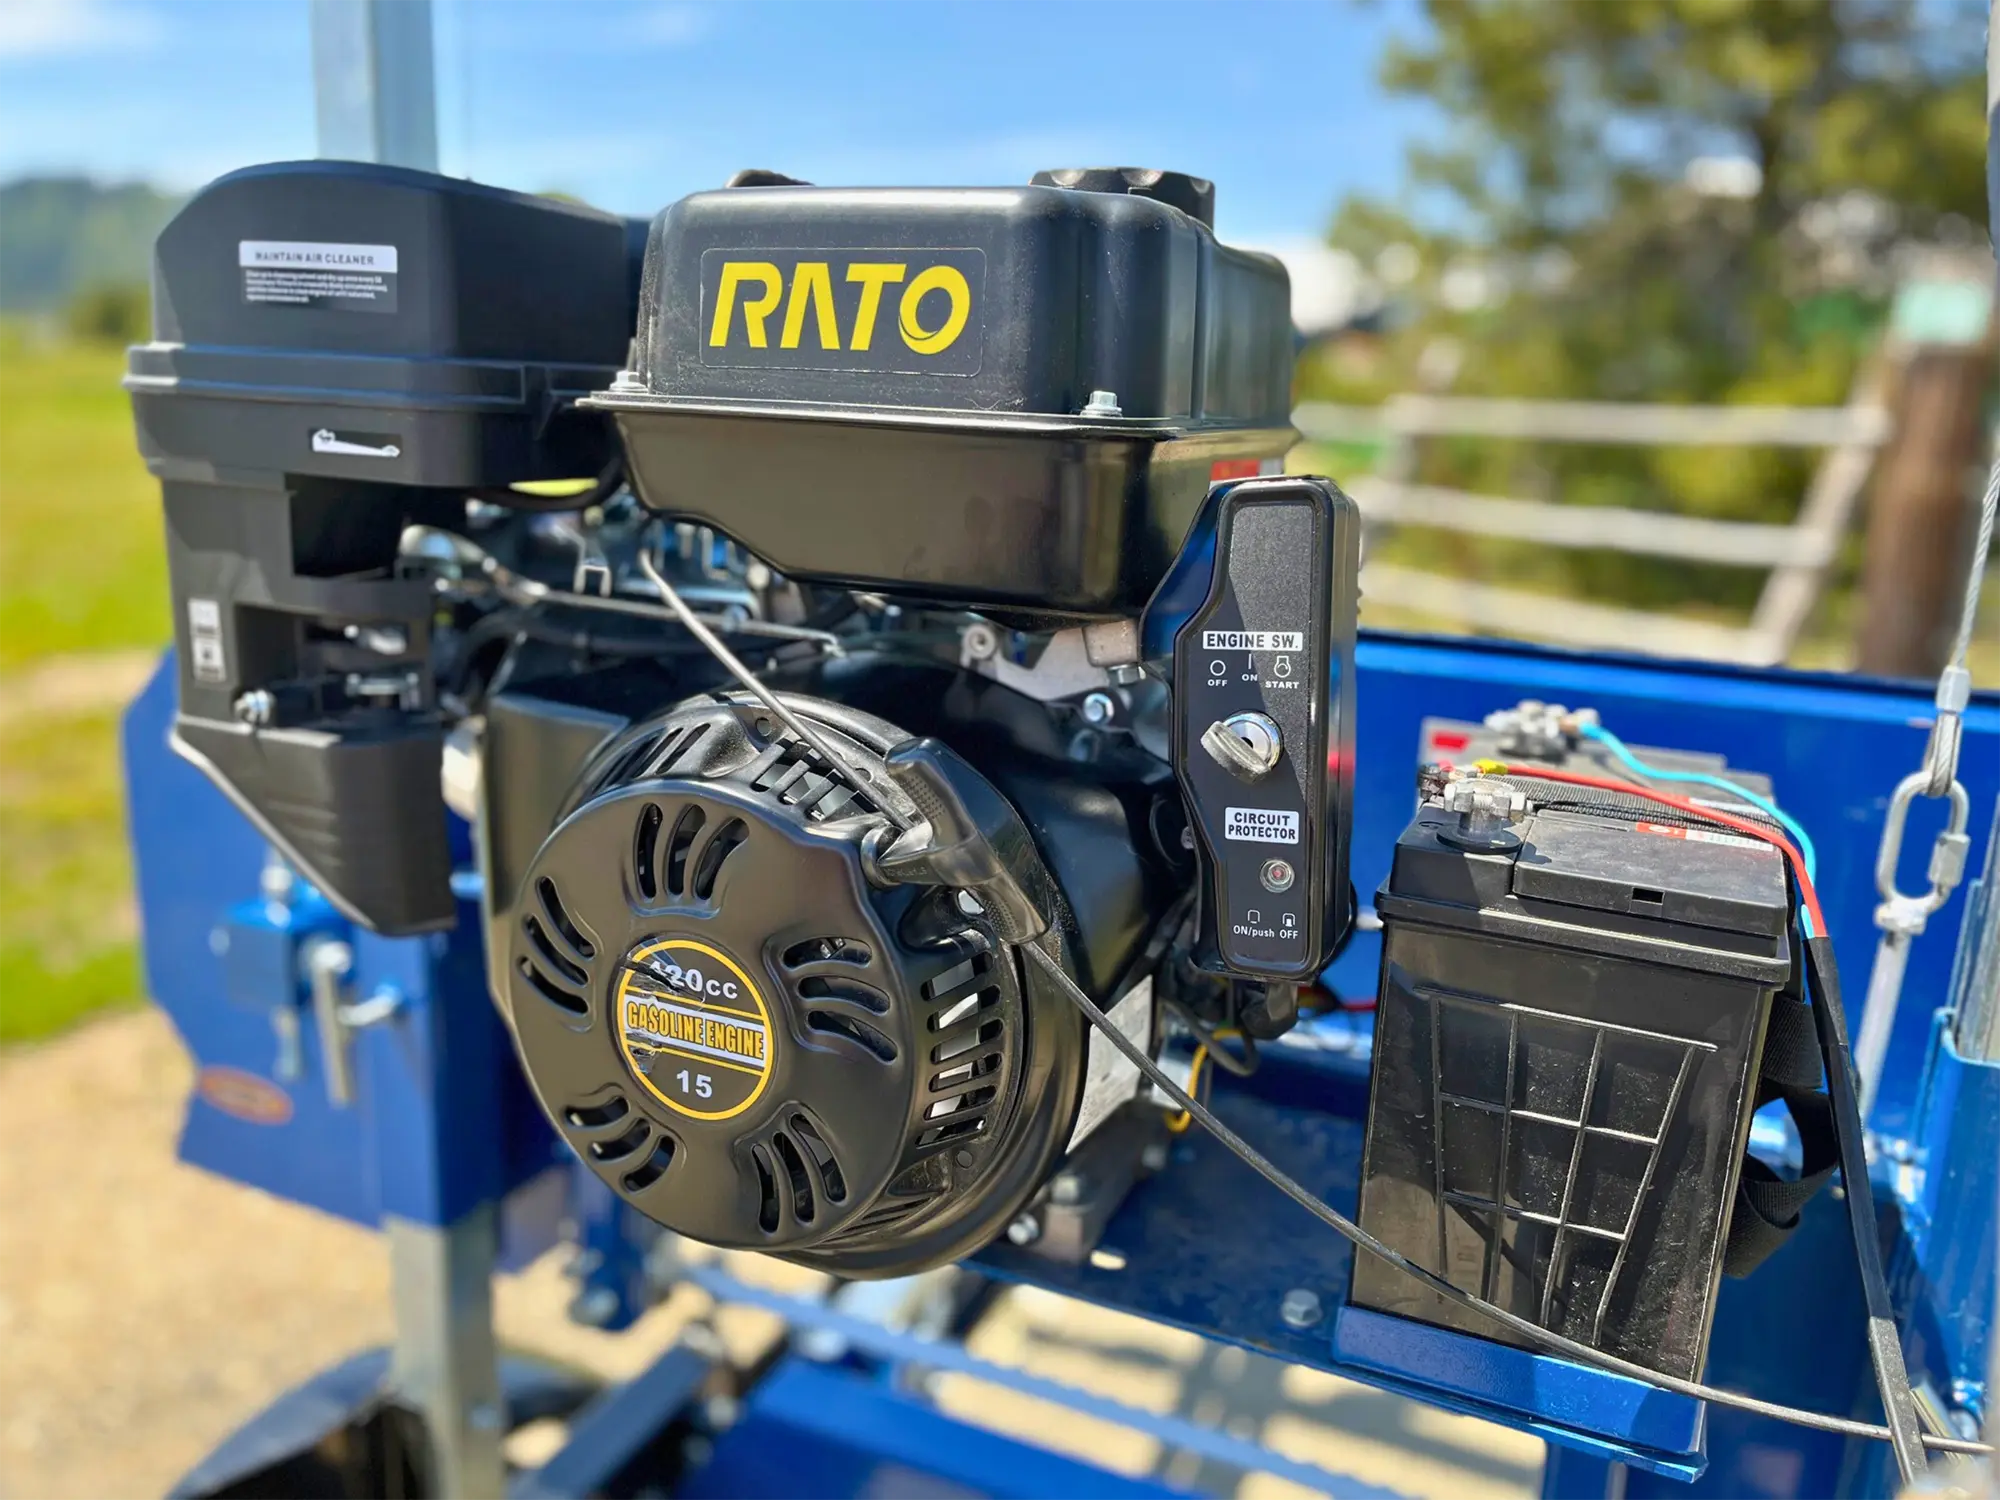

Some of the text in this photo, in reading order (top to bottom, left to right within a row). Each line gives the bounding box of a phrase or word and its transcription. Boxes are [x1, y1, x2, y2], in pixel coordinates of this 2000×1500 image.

[255, 251, 374, 265] MAINTAIN AIR CLEANER
[709, 262, 970, 355] RATO
[1206, 633, 1299, 649] ENGINE SW.
[1207, 679, 1228, 687] OFF
[1241, 673, 1258, 681] ON
[1265, 680, 1300, 689] START
[1234, 812, 1291, 826] CIRCUIT
[1228, 824, 1296, 840] PROTECTOR
[1233, 924, 1275, 938] ON/push
[1279, 929, 1299, 940] OFF
[627, 1001, 764, 1061] GASOLINE ENGINE
[676, 1069, 713, 1099] 15
